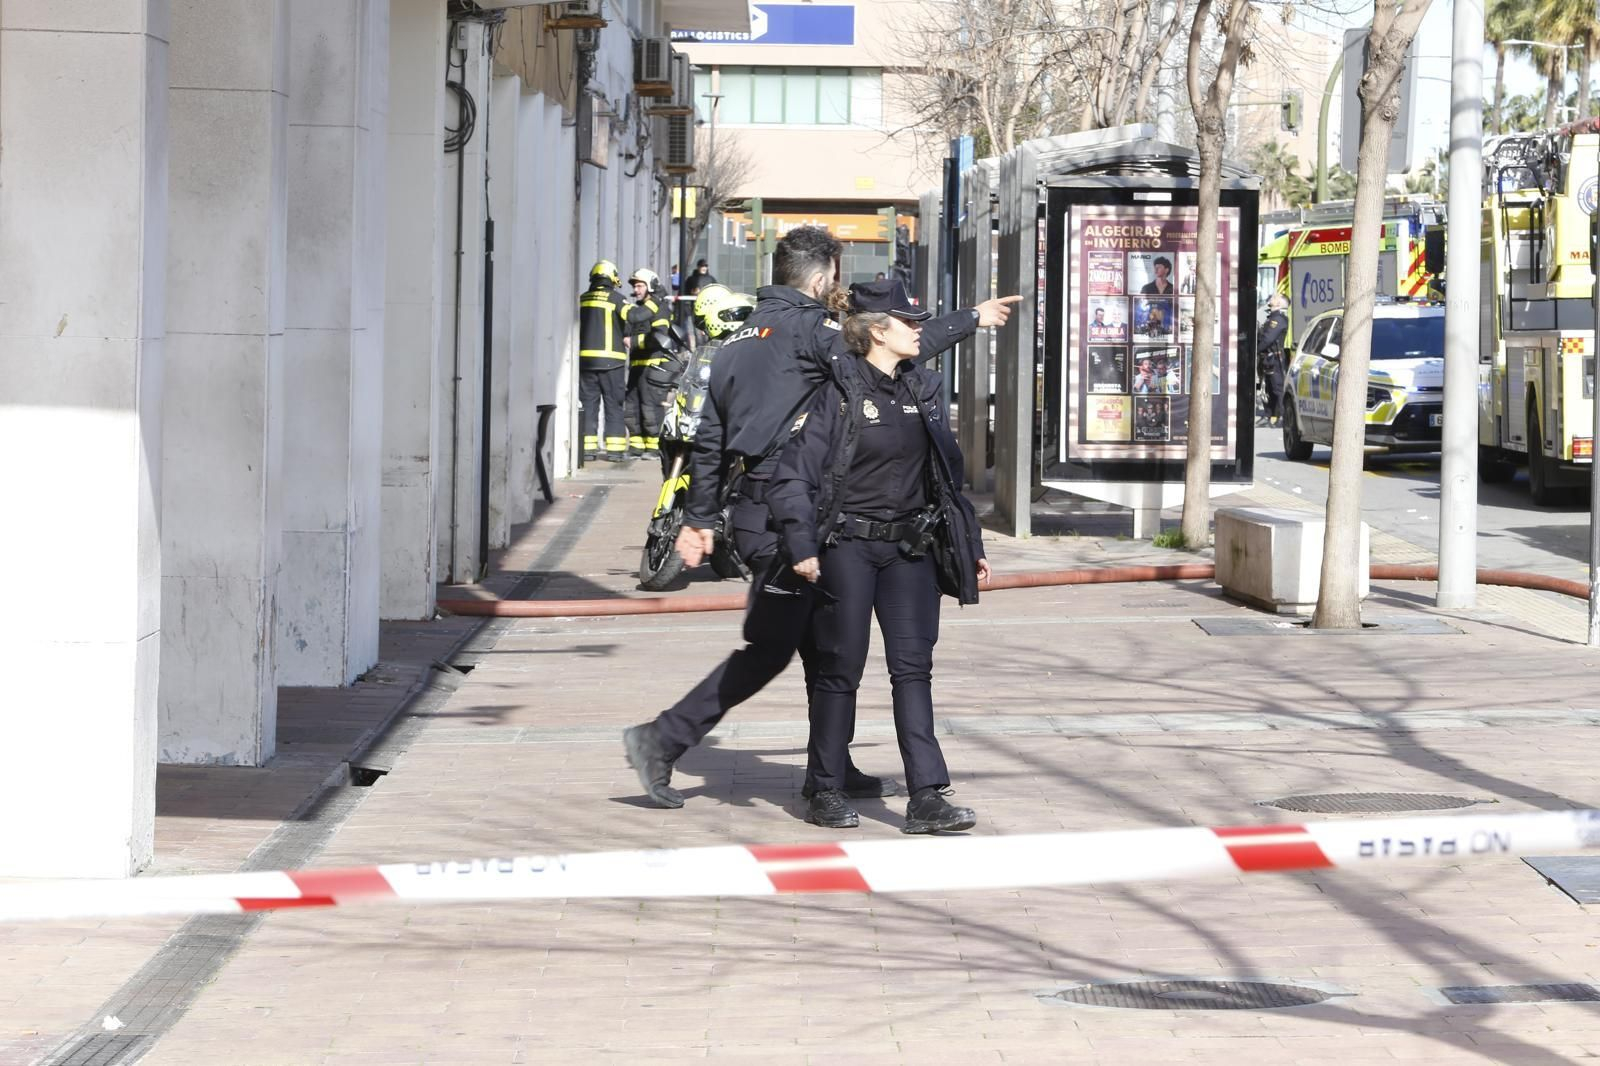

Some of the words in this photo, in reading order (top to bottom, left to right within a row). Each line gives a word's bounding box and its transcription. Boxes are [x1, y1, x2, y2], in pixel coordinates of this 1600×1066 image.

[1084, 225, 1161, 237] ALGECIRAS
[1094, 238, 1161, 249] INVIERNO
[1320, 242, 1349, 254] BOMB
[1310, 279, 1334, 303] 085
